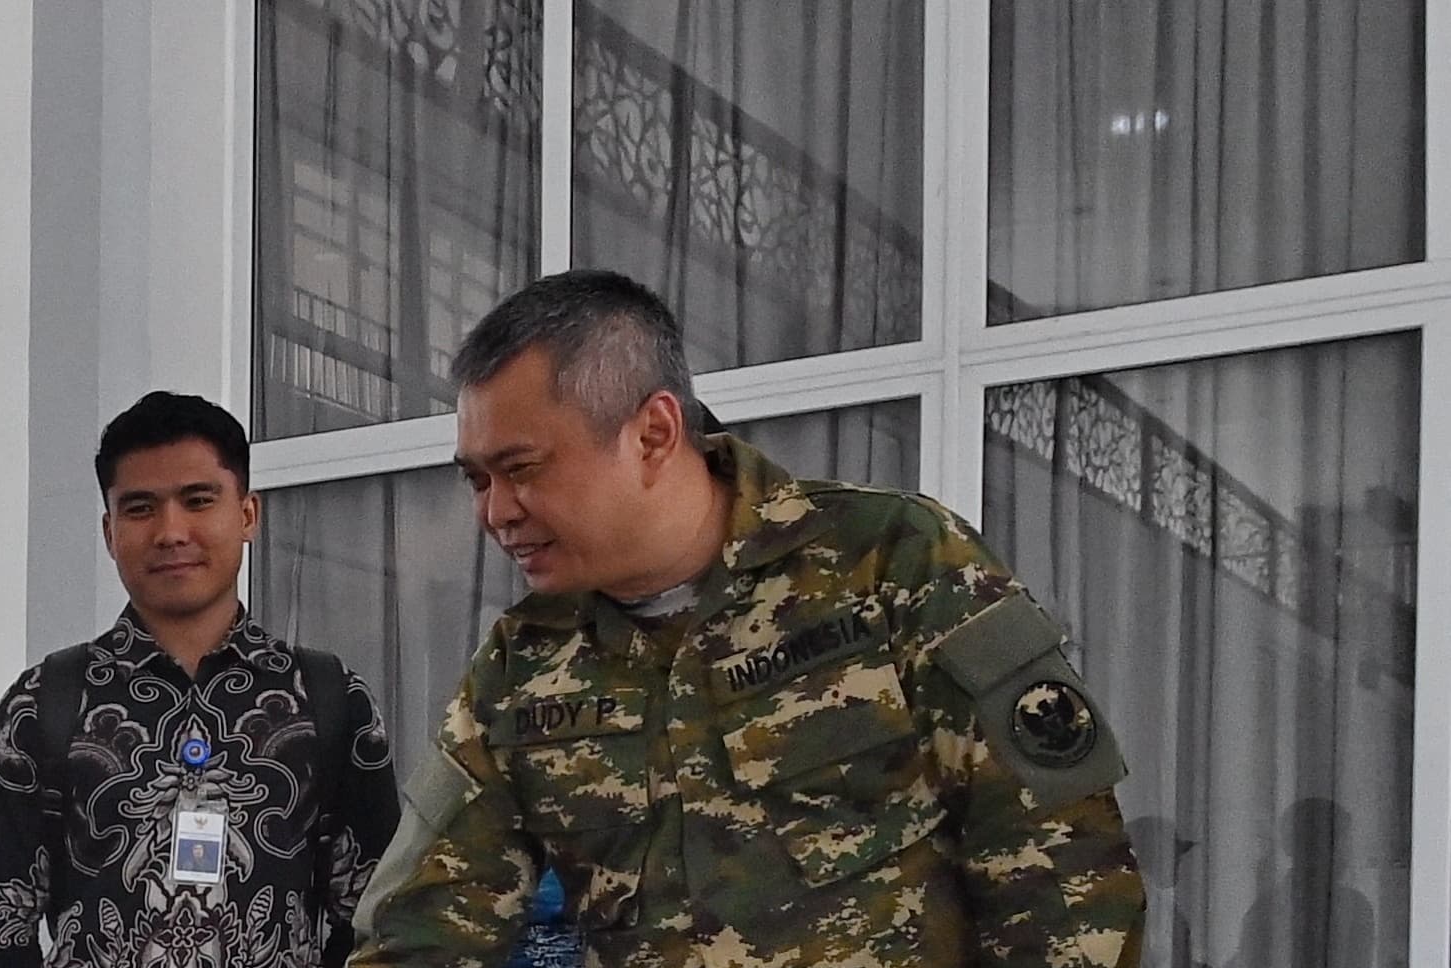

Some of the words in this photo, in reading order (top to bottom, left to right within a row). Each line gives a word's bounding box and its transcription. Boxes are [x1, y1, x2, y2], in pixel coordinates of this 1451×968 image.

[726, 612, 871, 692] INDONESIA
[515, 699, 583, 736] DUDY
[596, 697, 617, 726] P
